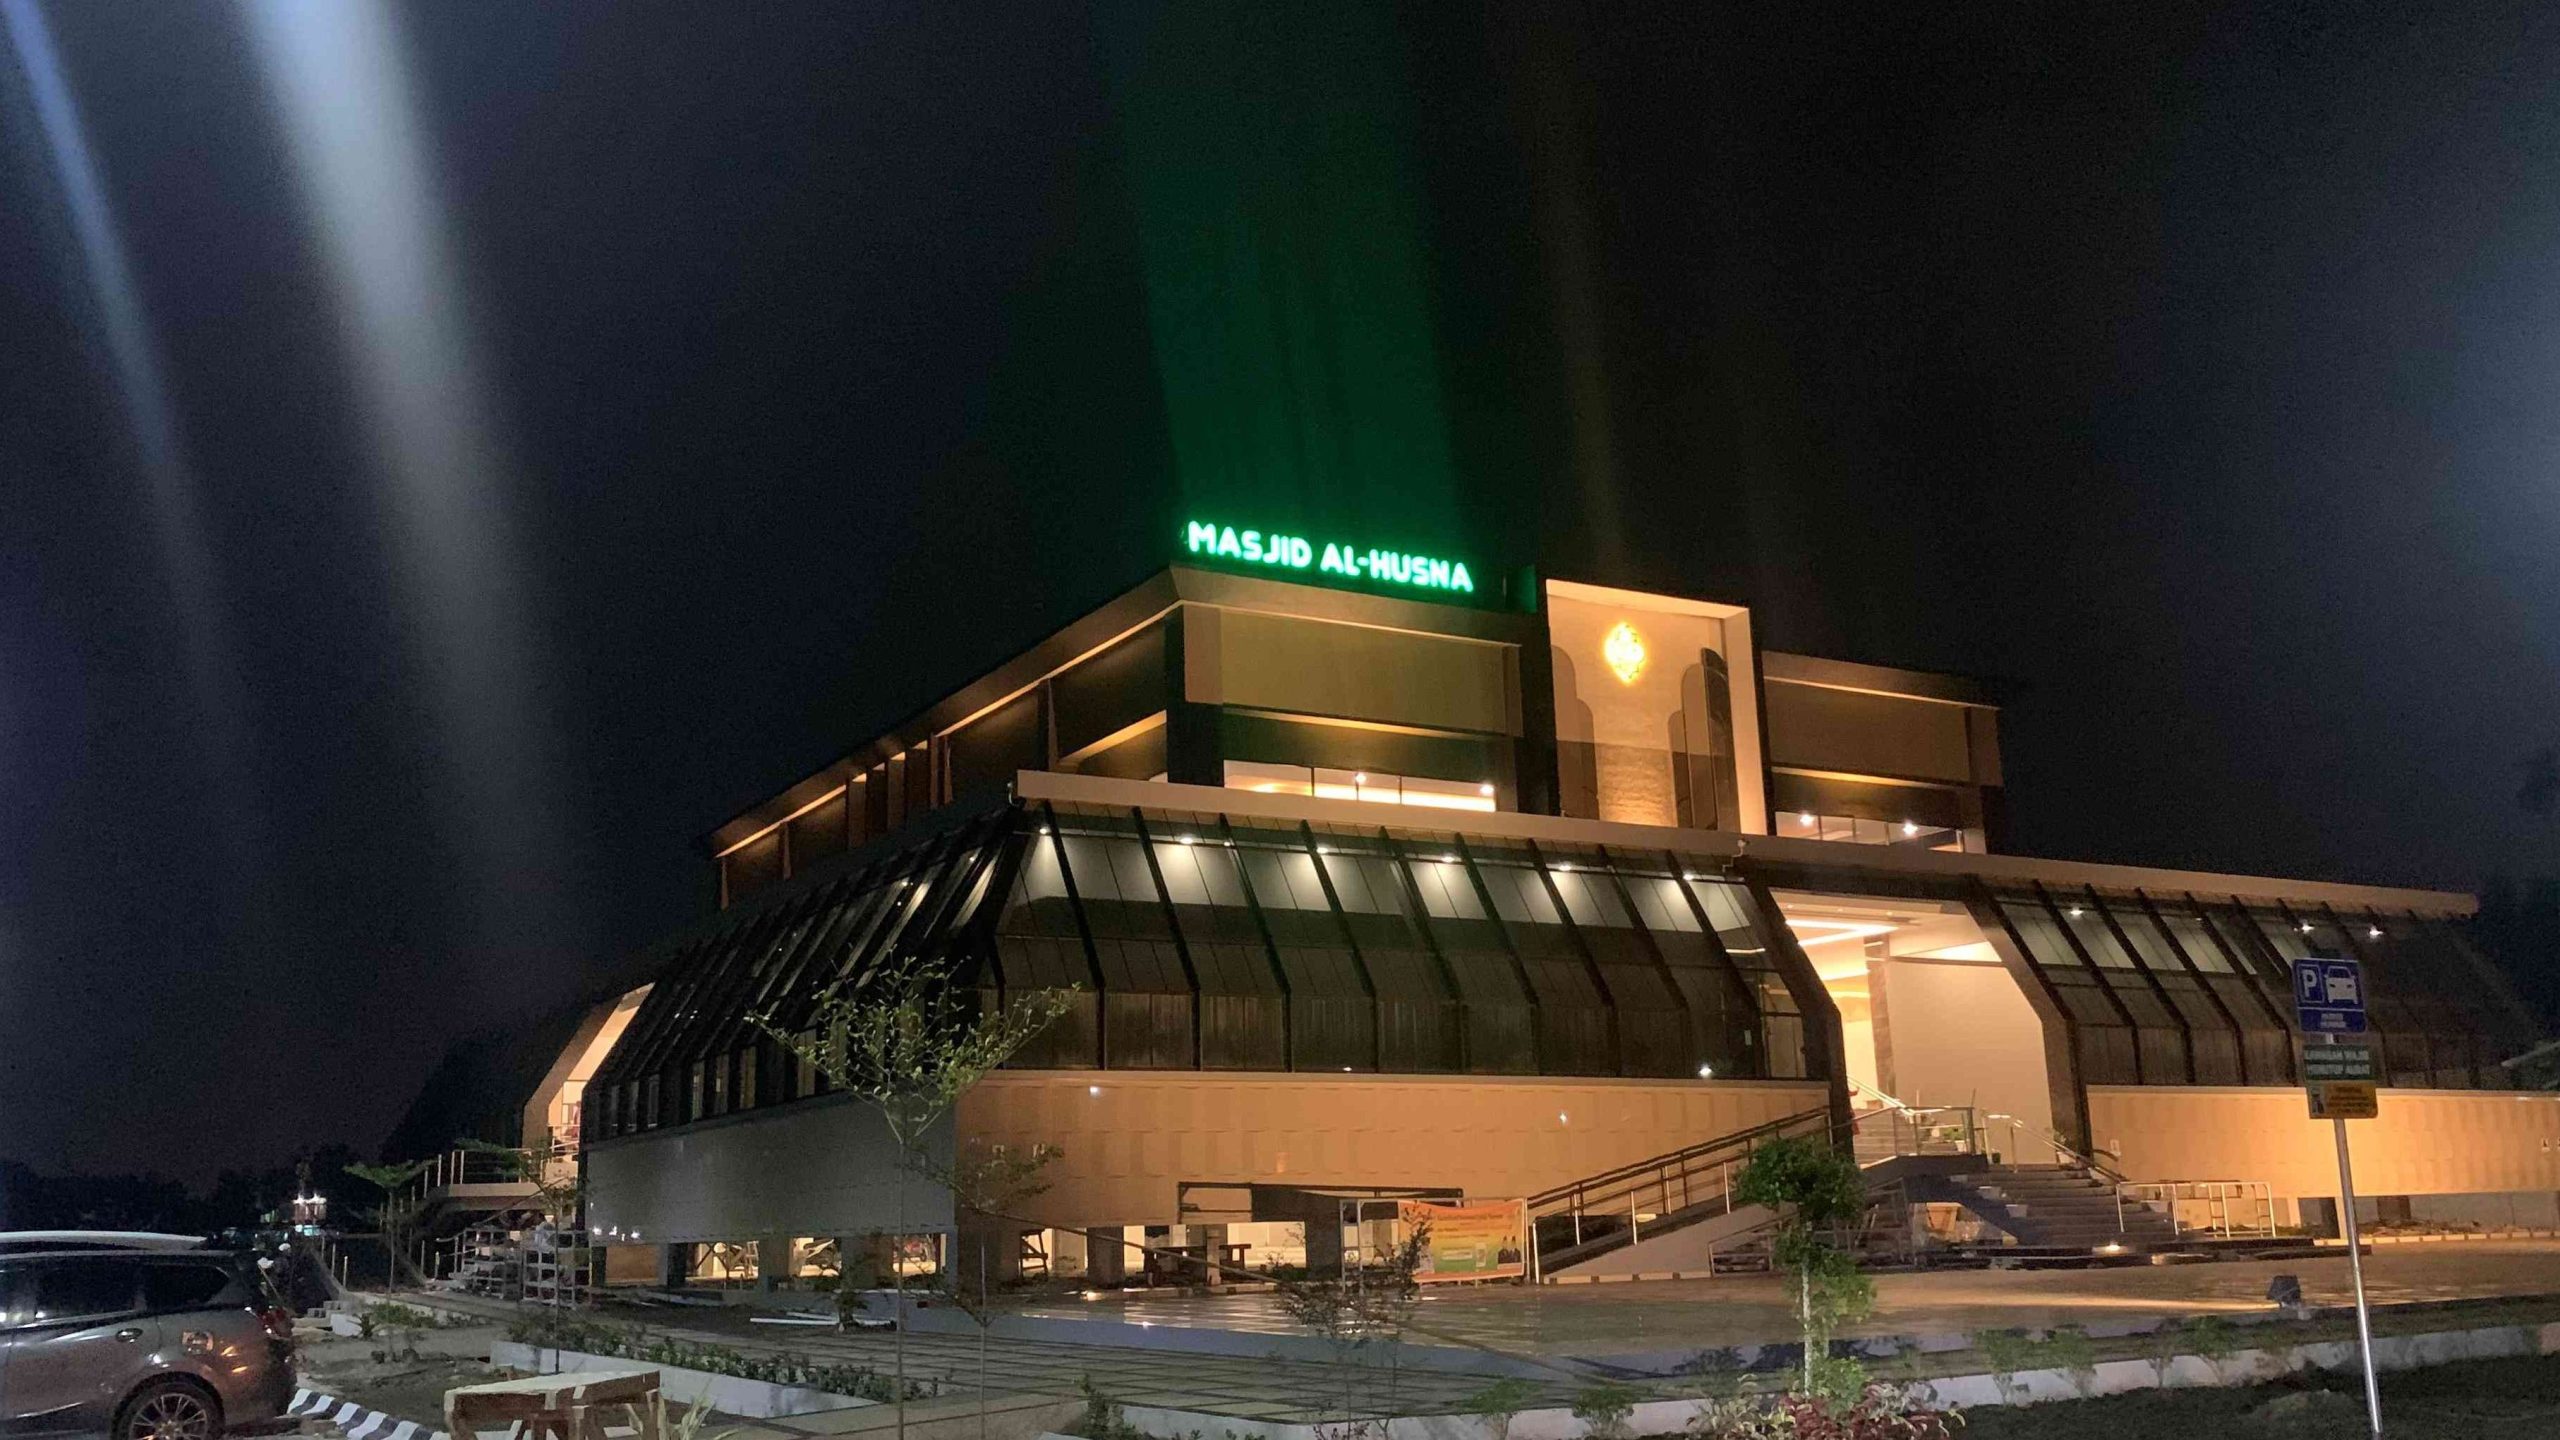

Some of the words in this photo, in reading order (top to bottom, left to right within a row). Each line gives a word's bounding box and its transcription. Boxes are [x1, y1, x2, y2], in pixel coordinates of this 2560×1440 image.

[1187, 520, 1313, 568] MASJID
[1320, 542, 1474, 592] AL-HUSNA
[2302, 969, 2317, 997] P
